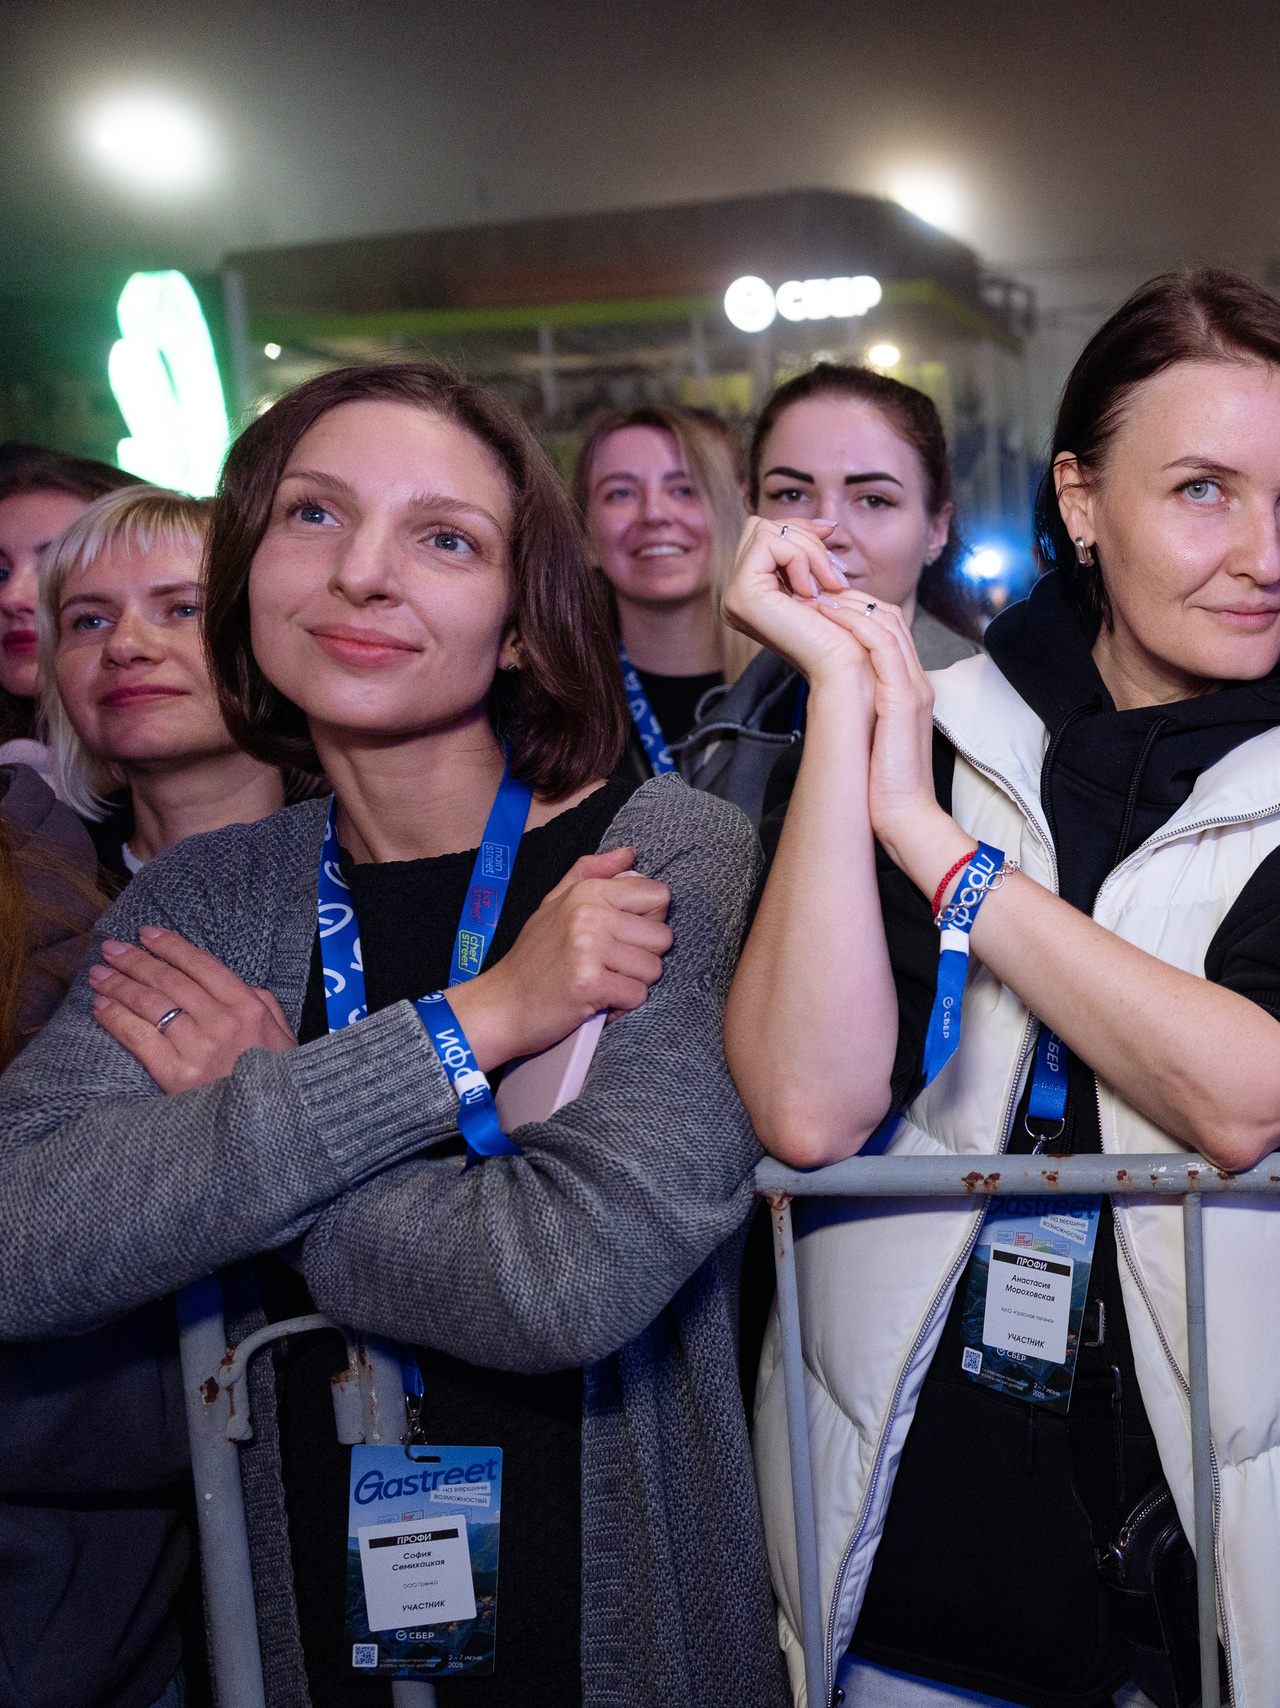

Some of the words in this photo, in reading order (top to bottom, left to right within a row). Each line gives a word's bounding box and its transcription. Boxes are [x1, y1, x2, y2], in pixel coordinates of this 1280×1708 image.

[485, 844, 495, 875] street
[494, 847, 506, 872] main
[473, 887, 482, 920] street
[461, 932, 470, 968] street
[469, 936, 479, 964] chef
[942, 1011, 951, 1039] СБЕР
[1042, 1220, 1085, 1242] возможностей
[1059, 1218, 1087, 1229] вершине
[1016, 1256, 1048, 1271] ПРОФИ
[1010, 1274, 1051, 1289] Анастасия
[1004, 1284, 1056, 1302] Мороховская
[1007, 1332, 1046, 1348] УЧАСТНИК
[1006, 1350, 1027, 1362] СБЕР
[353, 1458, 498, 1505] Gastreet
[454, 1484, 488, 1494] вершине
[433, 1493, 488, 1505] возможностей
[396, 1532, 432, 1545] ПРОФИ
[403, 1551, 432, 1560] София
[391, 1559, 445, 1571] Семихацкая
[401, 1599, 446, 1612] УЧАСТНИК
[408, 1631, 435, 1640] СБЕР
